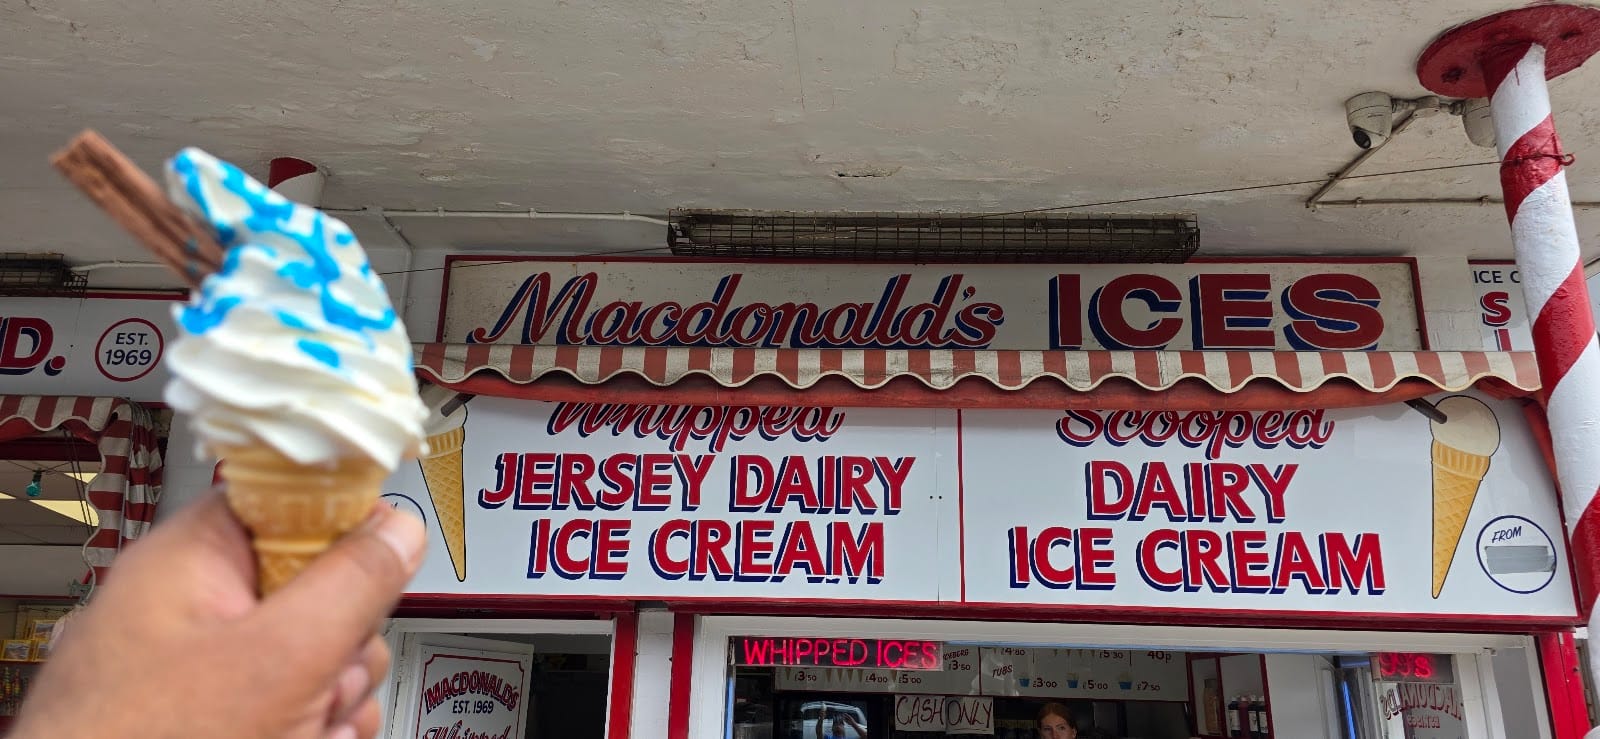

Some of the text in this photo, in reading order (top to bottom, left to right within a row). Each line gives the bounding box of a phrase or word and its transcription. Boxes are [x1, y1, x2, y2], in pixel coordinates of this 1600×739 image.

[1473, 270, 1503, 284] ICE
[466, 271, 1385, 350] Macdonald's ICES
[115, 332, 148, 346] EST.
[105, 349, 152, 366] 1969
[1055, 408, 1335, 460] Scooped
[478, 453, 916, 515] JERSEY DAIRY
[1085, 460, 1299, 524] DAIRY
[1491, 525, 1522, 544] FROM
[526, 518, 885, 585] ICE CREAM
[1008, 525, 1387, 596] ICE CREAM
[743, 638, 938, 669] WHIPPED ICES
[452, 700, 494, 714] EST. 1969
[896, 696, 993, 729] CASH ONLY
